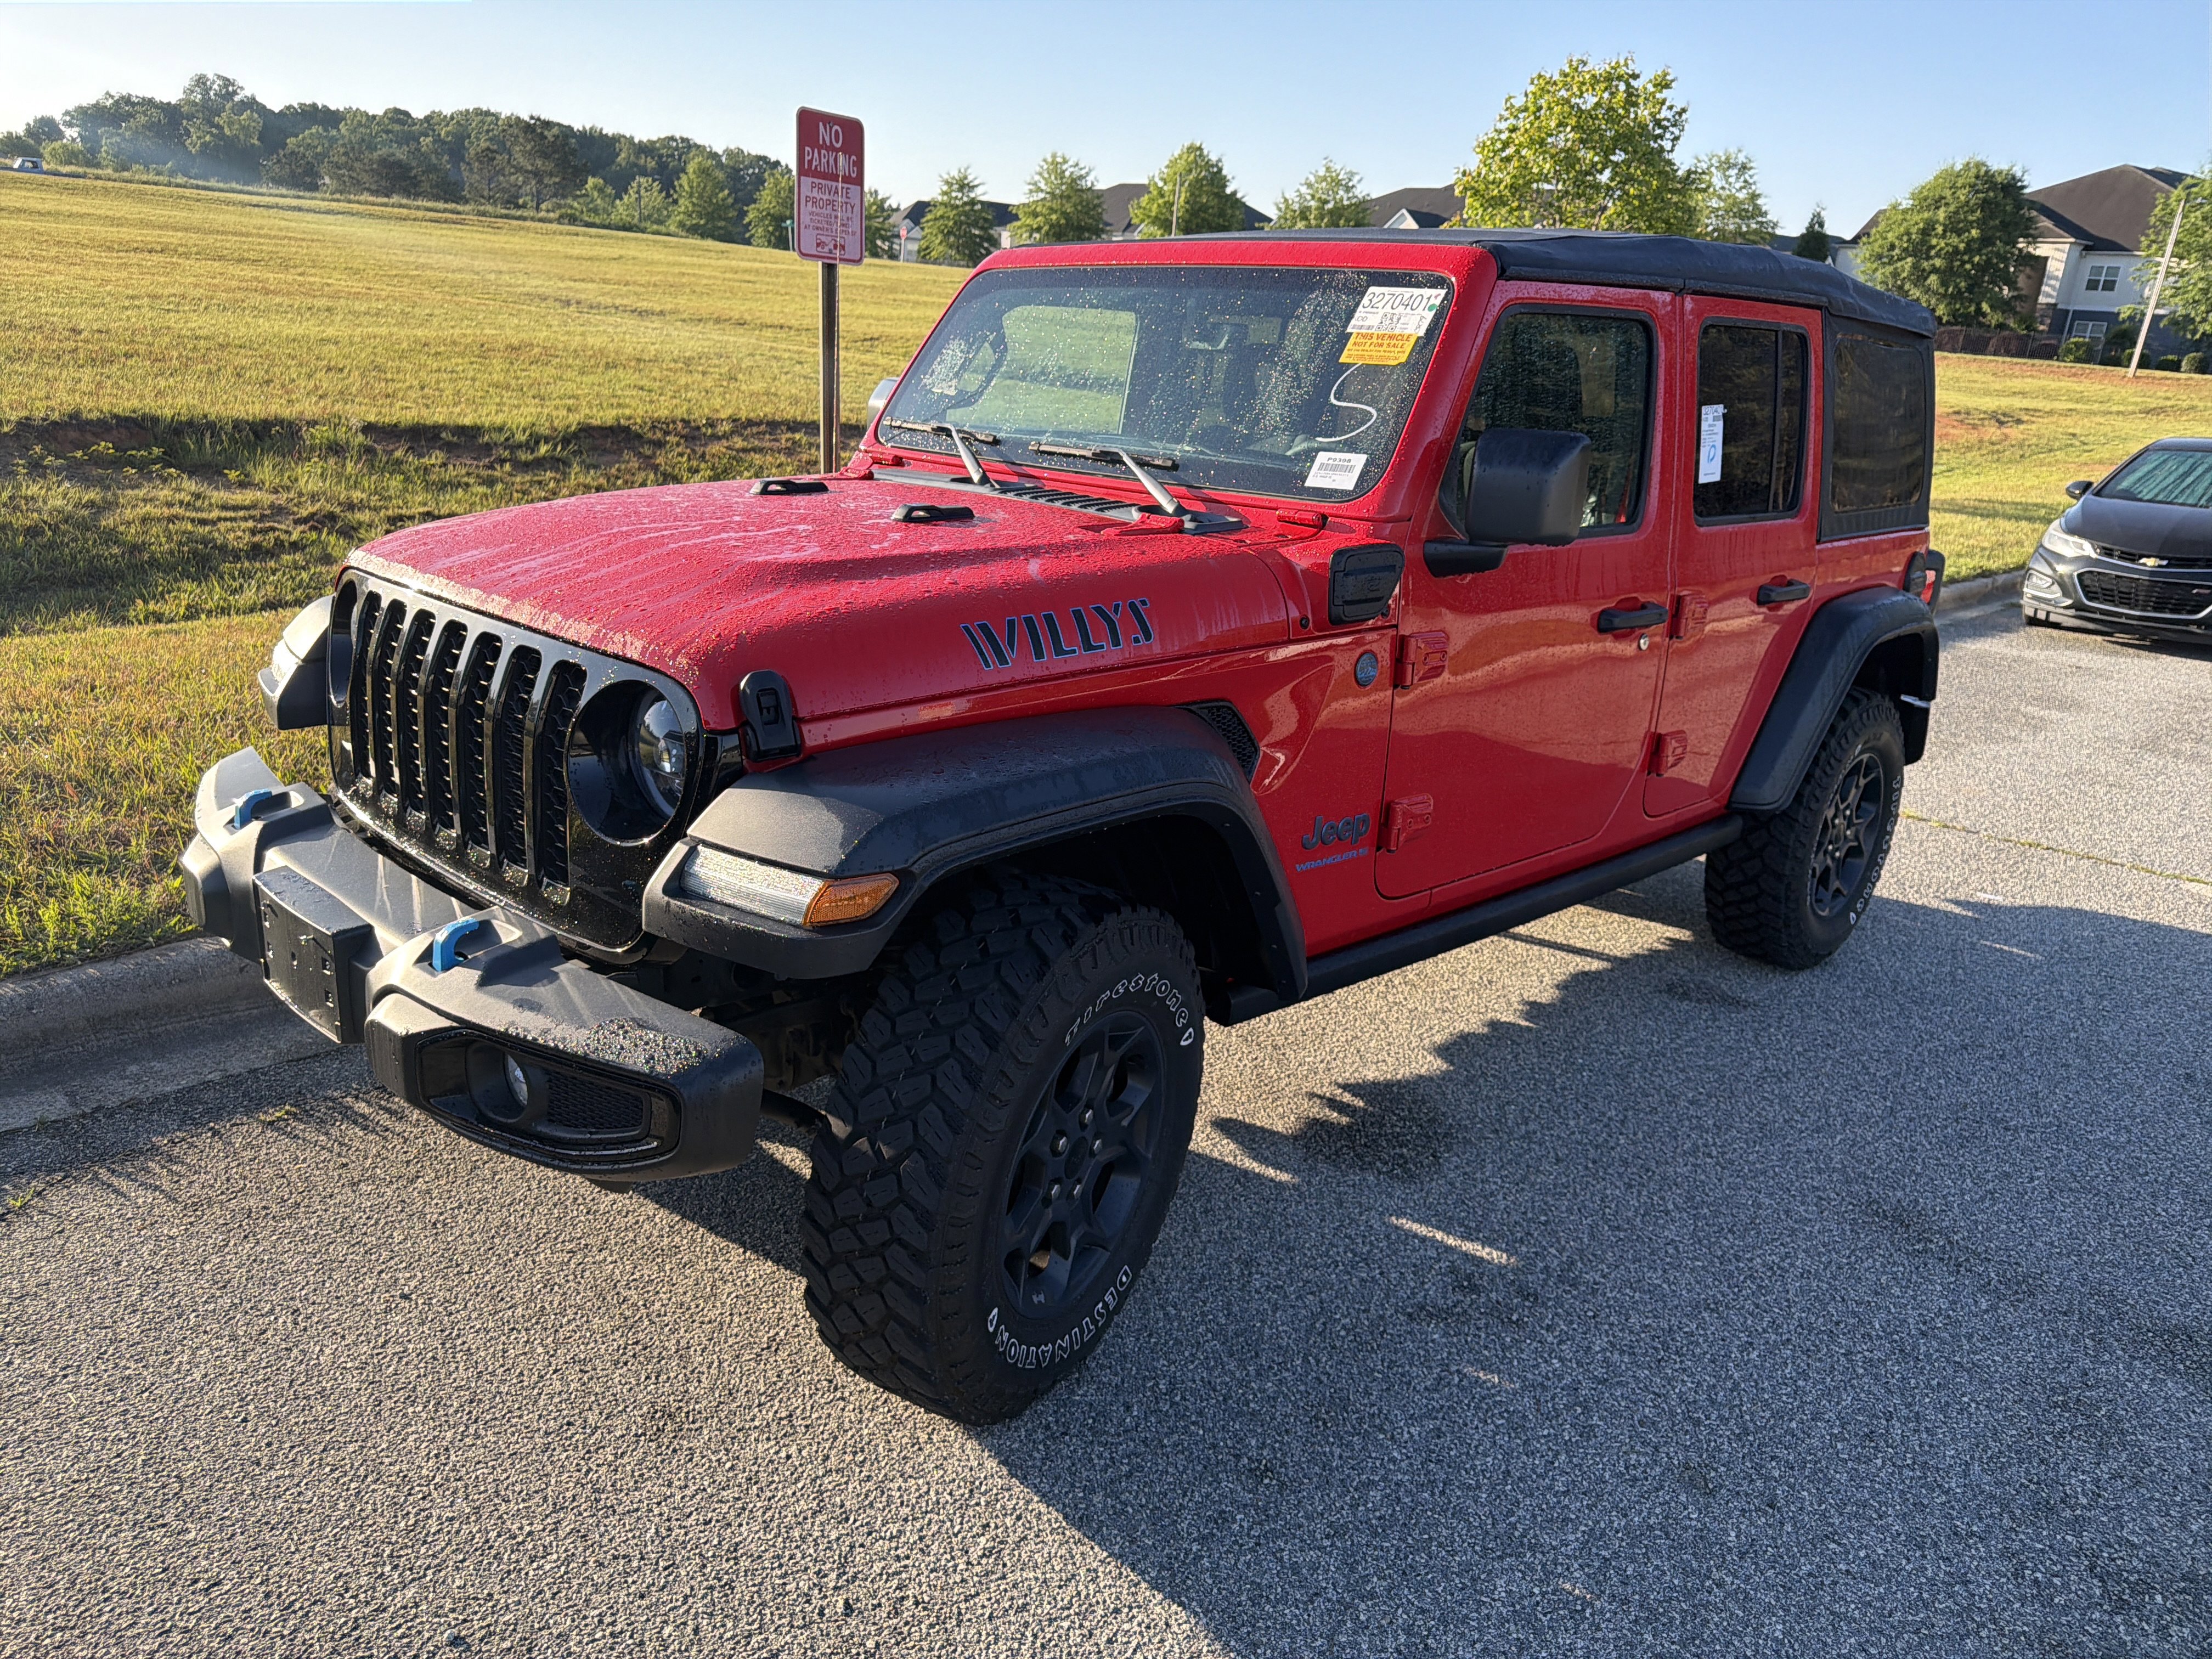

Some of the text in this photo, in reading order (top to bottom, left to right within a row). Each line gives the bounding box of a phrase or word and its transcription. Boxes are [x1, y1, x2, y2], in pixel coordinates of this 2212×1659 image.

[819, 121, 843, 148] NO
[804, 146, 857, 178] PARKING
[811, 181, 851, 199] PRIVATE
[805, 195, 856, 214] PROPERTY
[1362, 292, 1433, 312] 3270401
[1355, 332, 1413, 342] THIS VEHICLE
[960, 597, 1153, 670] WILLYS
[1301, 812, 1371, 850] Jeep
[1295, 850, 1358, 872] WRANGLER
[1065, 973, 1189, 1046] Firestone
[995, 1265, 1132, 1368] DESTINATION
